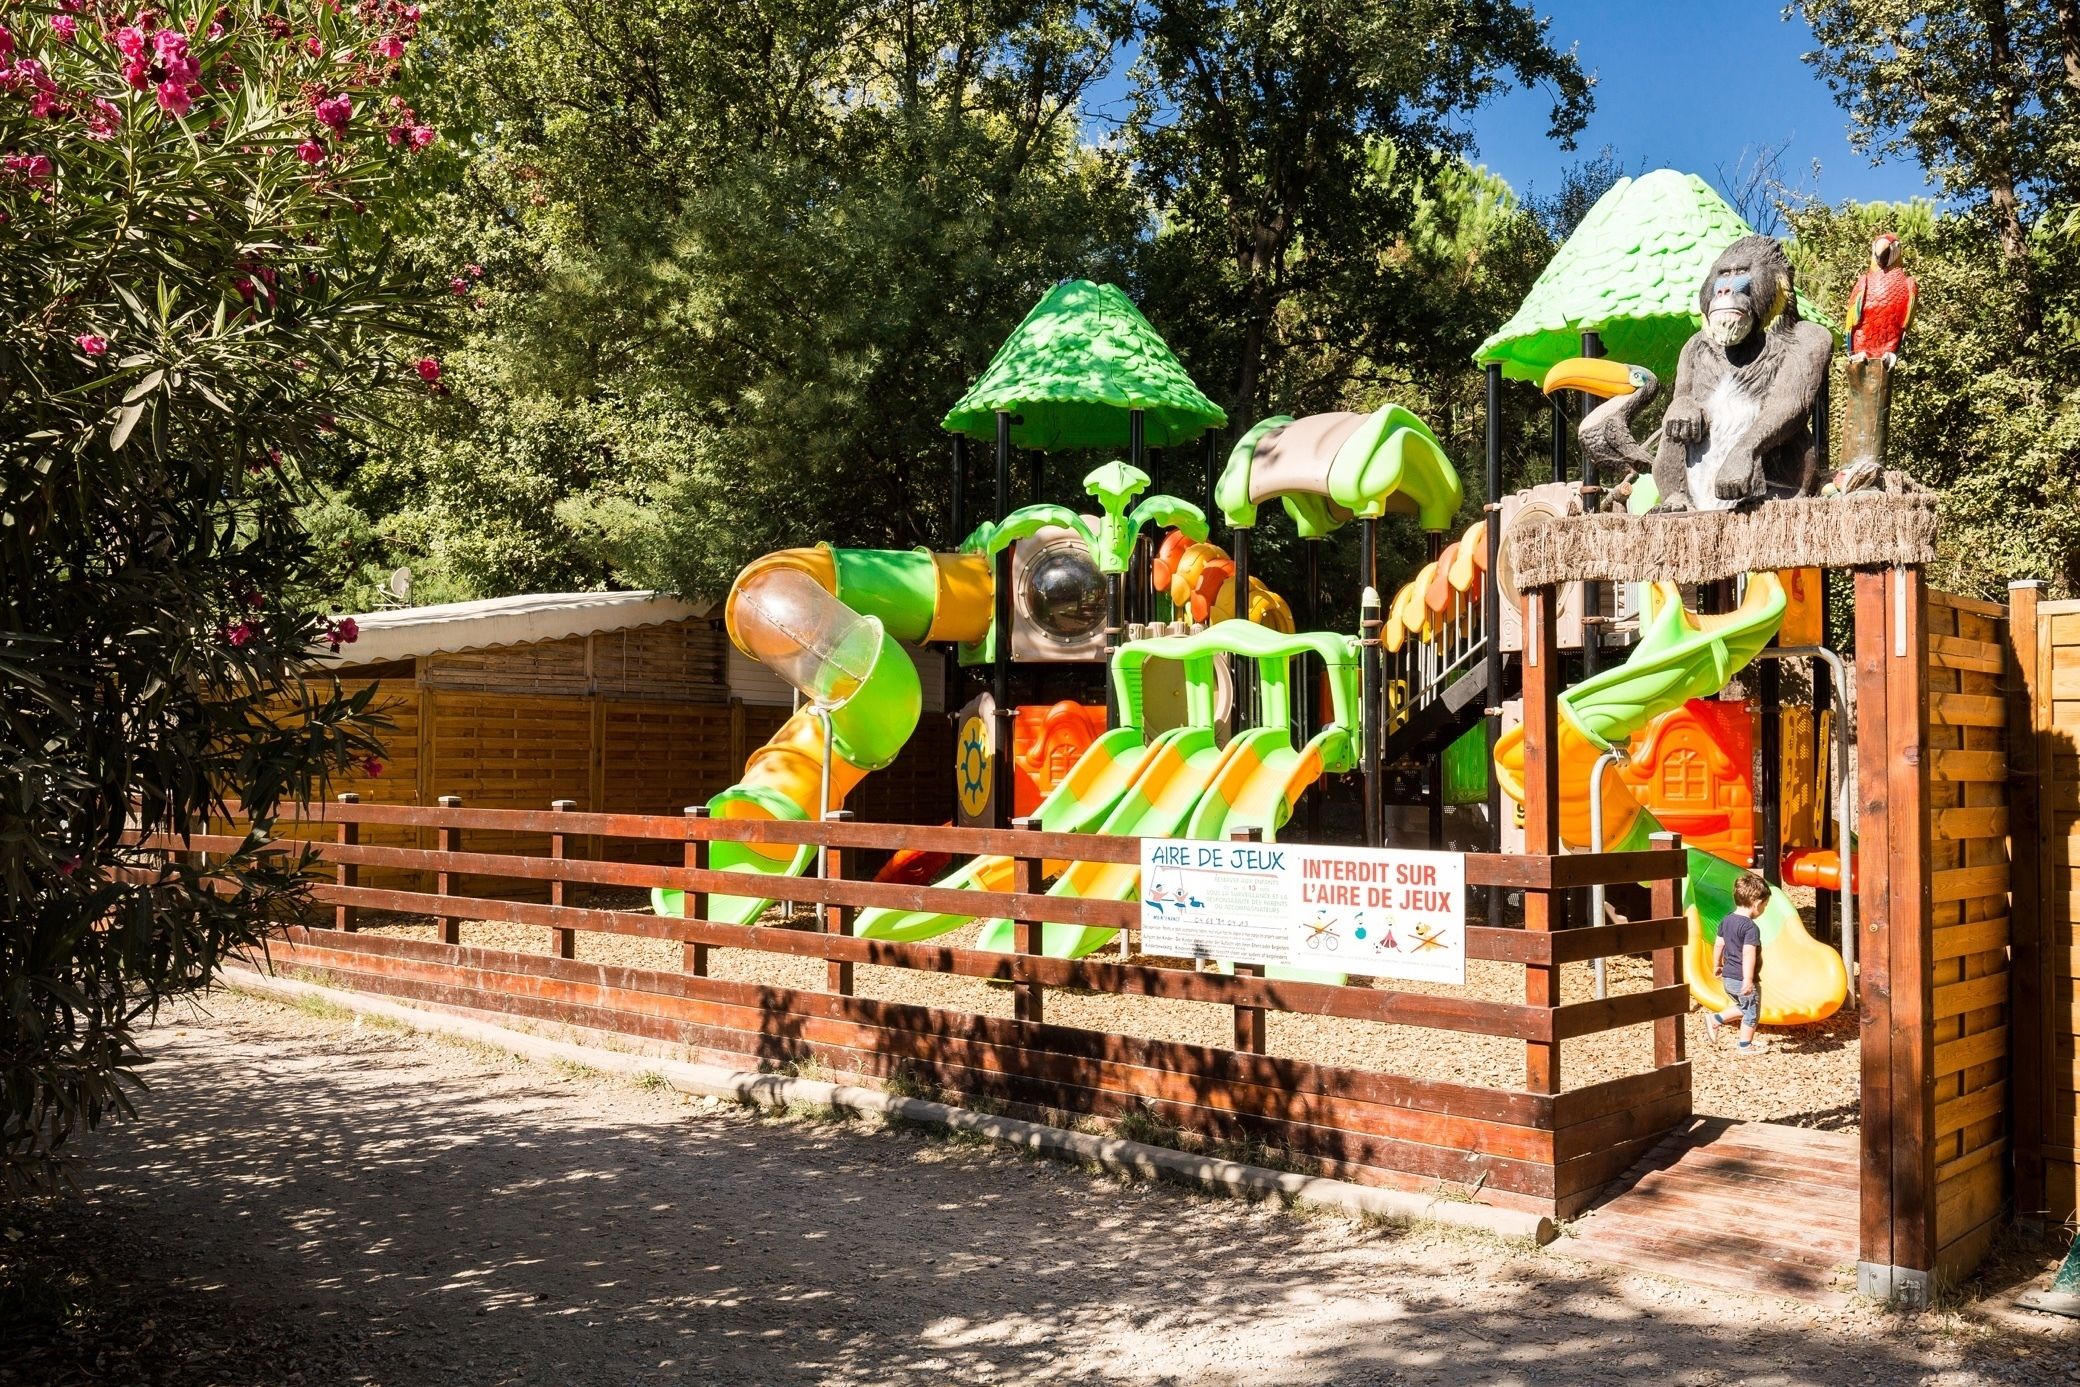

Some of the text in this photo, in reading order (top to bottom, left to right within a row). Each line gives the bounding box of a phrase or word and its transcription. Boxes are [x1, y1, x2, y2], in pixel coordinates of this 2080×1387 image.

[1152, 846, 1285, 870] AIRE DE JEUX
[1303, 859, 1436, 886] INTERDIT SUR
[1303, 883, 1451, 912] L'AIRE DE JEUX
